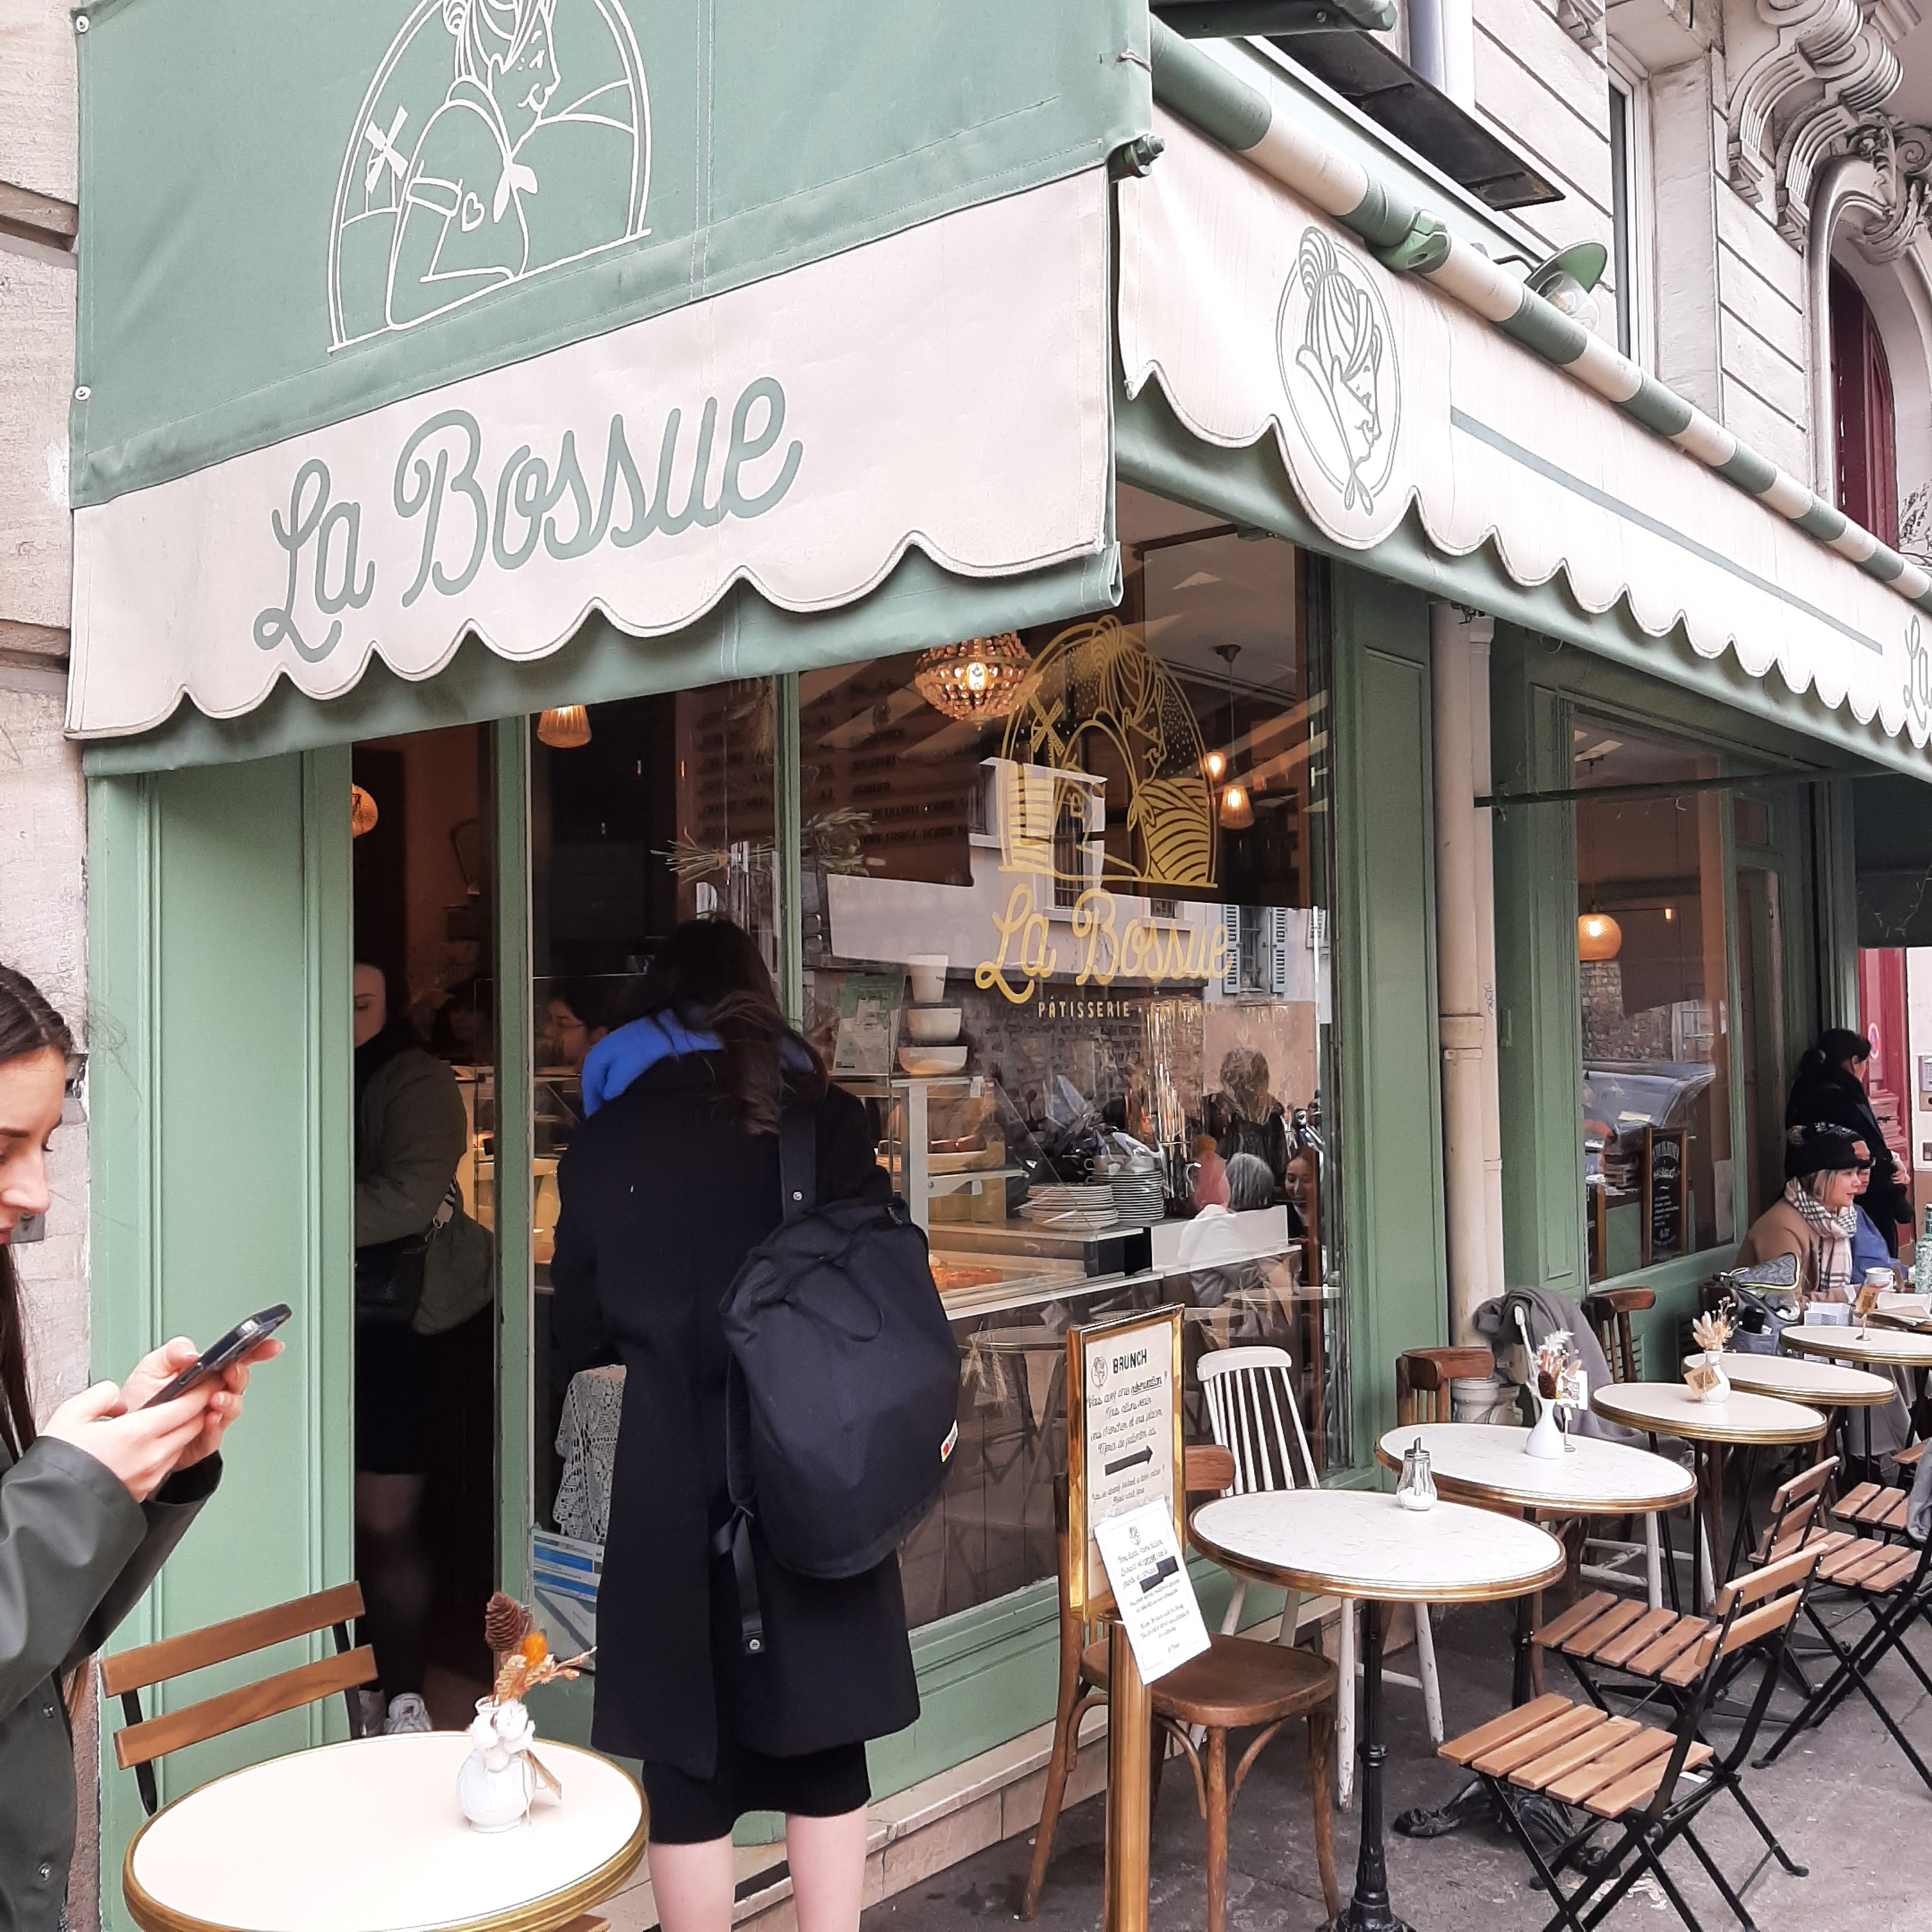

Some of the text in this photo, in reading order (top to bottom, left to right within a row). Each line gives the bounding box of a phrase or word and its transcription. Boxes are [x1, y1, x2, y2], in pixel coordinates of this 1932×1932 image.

[254, 377, 803, 663] La Bossue
[974, 883, 1234, 1004] La Bossue
[1038, 995, 1131, 1019] PÂTISSERIE
[1112, 1347, 1147, 1374] BRUNCH
